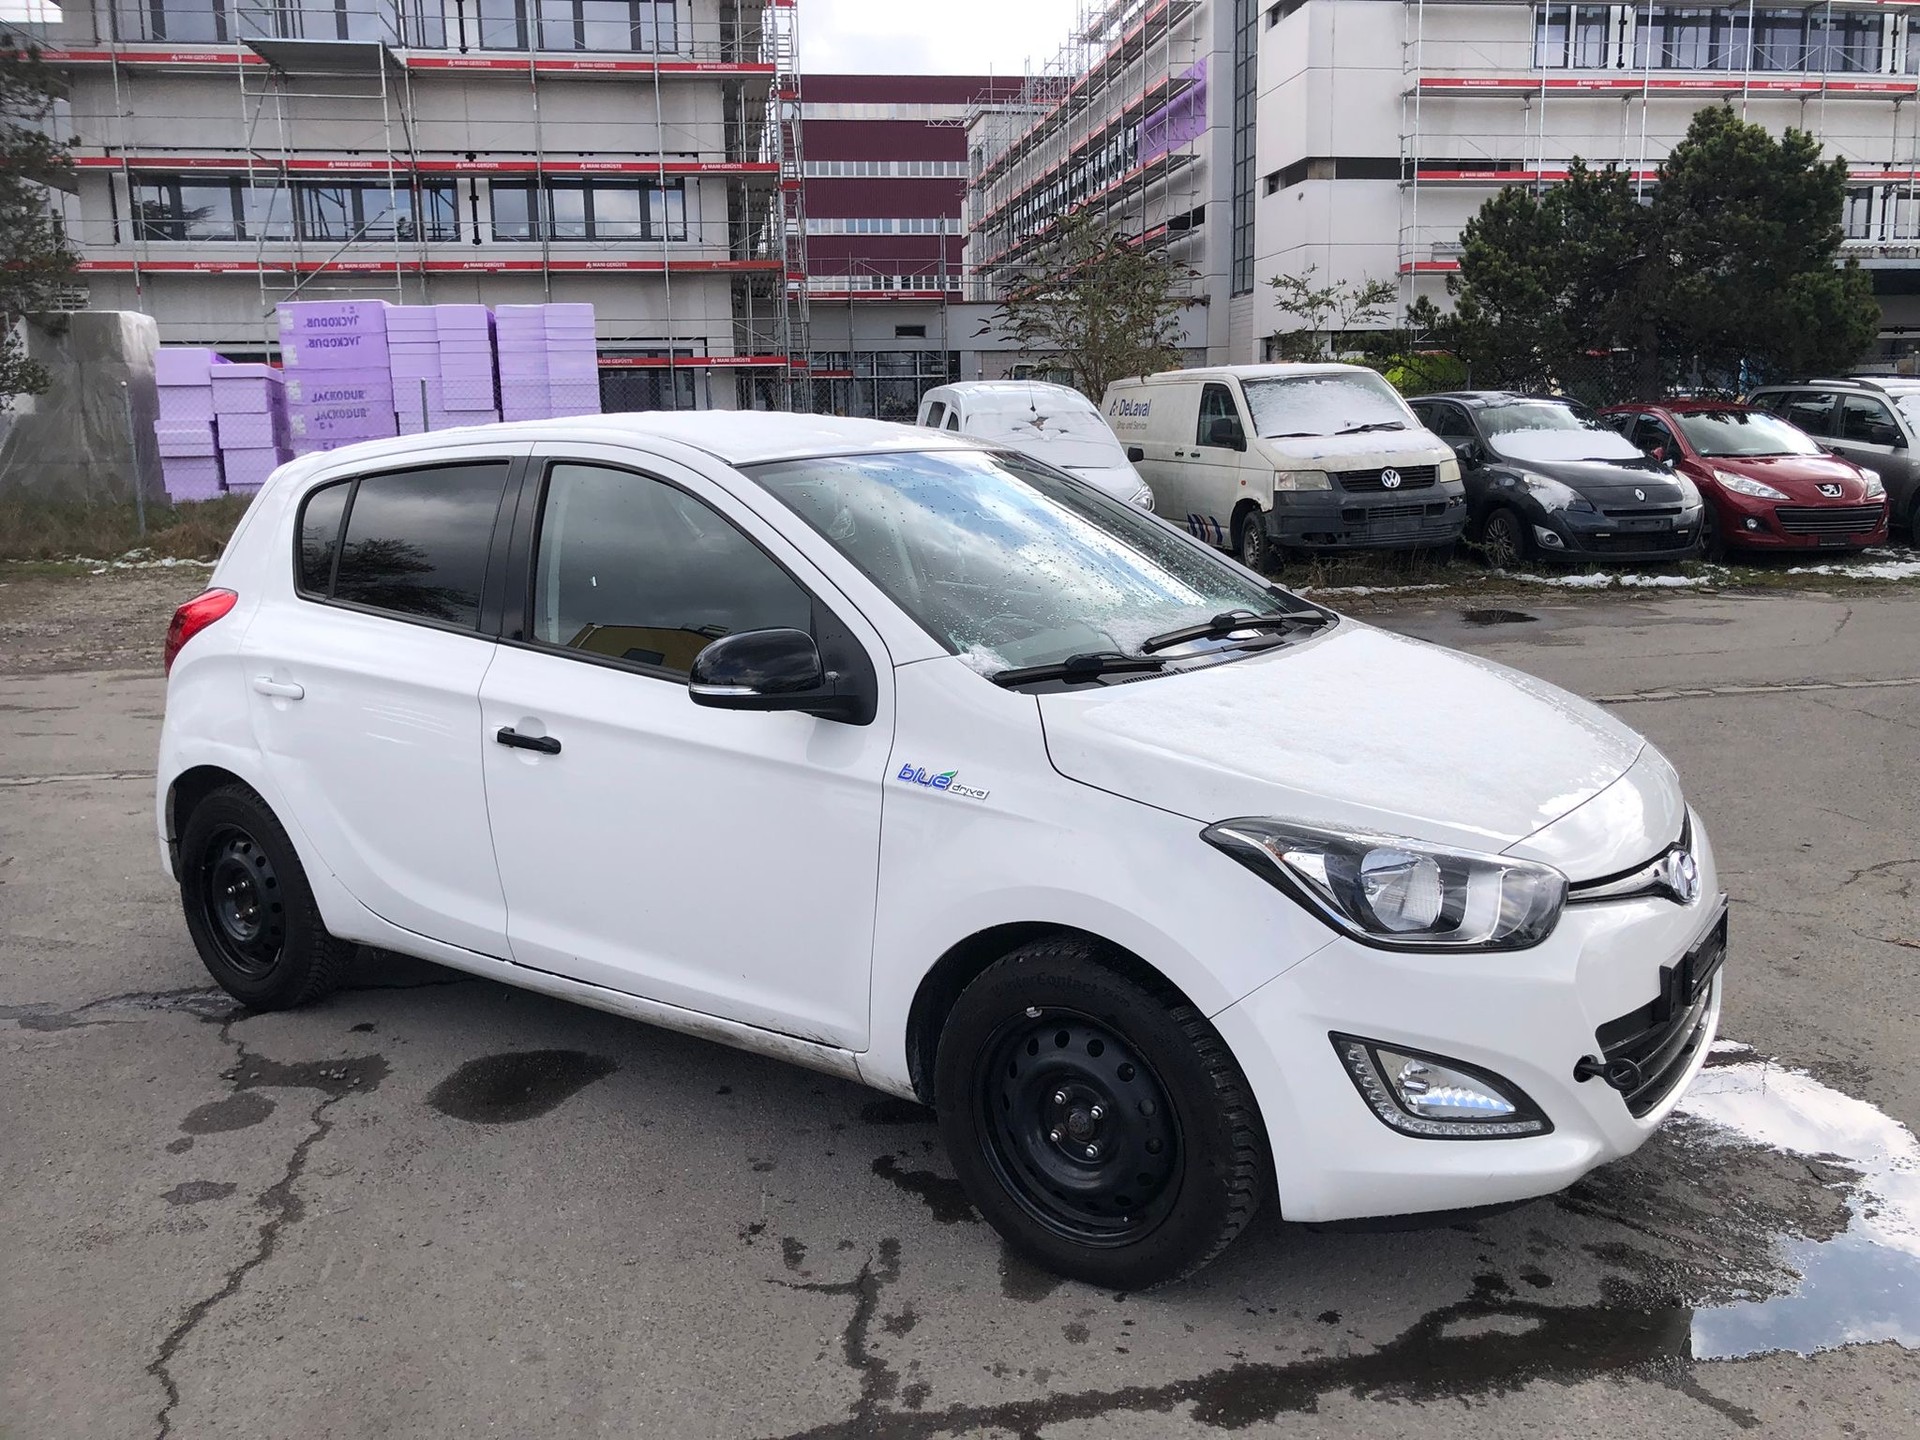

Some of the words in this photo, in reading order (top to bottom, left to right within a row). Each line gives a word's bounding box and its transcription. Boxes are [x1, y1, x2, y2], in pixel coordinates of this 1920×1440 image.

[305, 315, 359, 328] JACKODUR
[308, 335, 361, 348] JACKODUR
[311, 390, 365, 403] JACKODUR
[1118, 398, 1151, 416] DeLaval
[314, 408, 367, 421] JACKODUR
[897, 763, 952, 791] blue
[951, 784, 985, 797] drive
